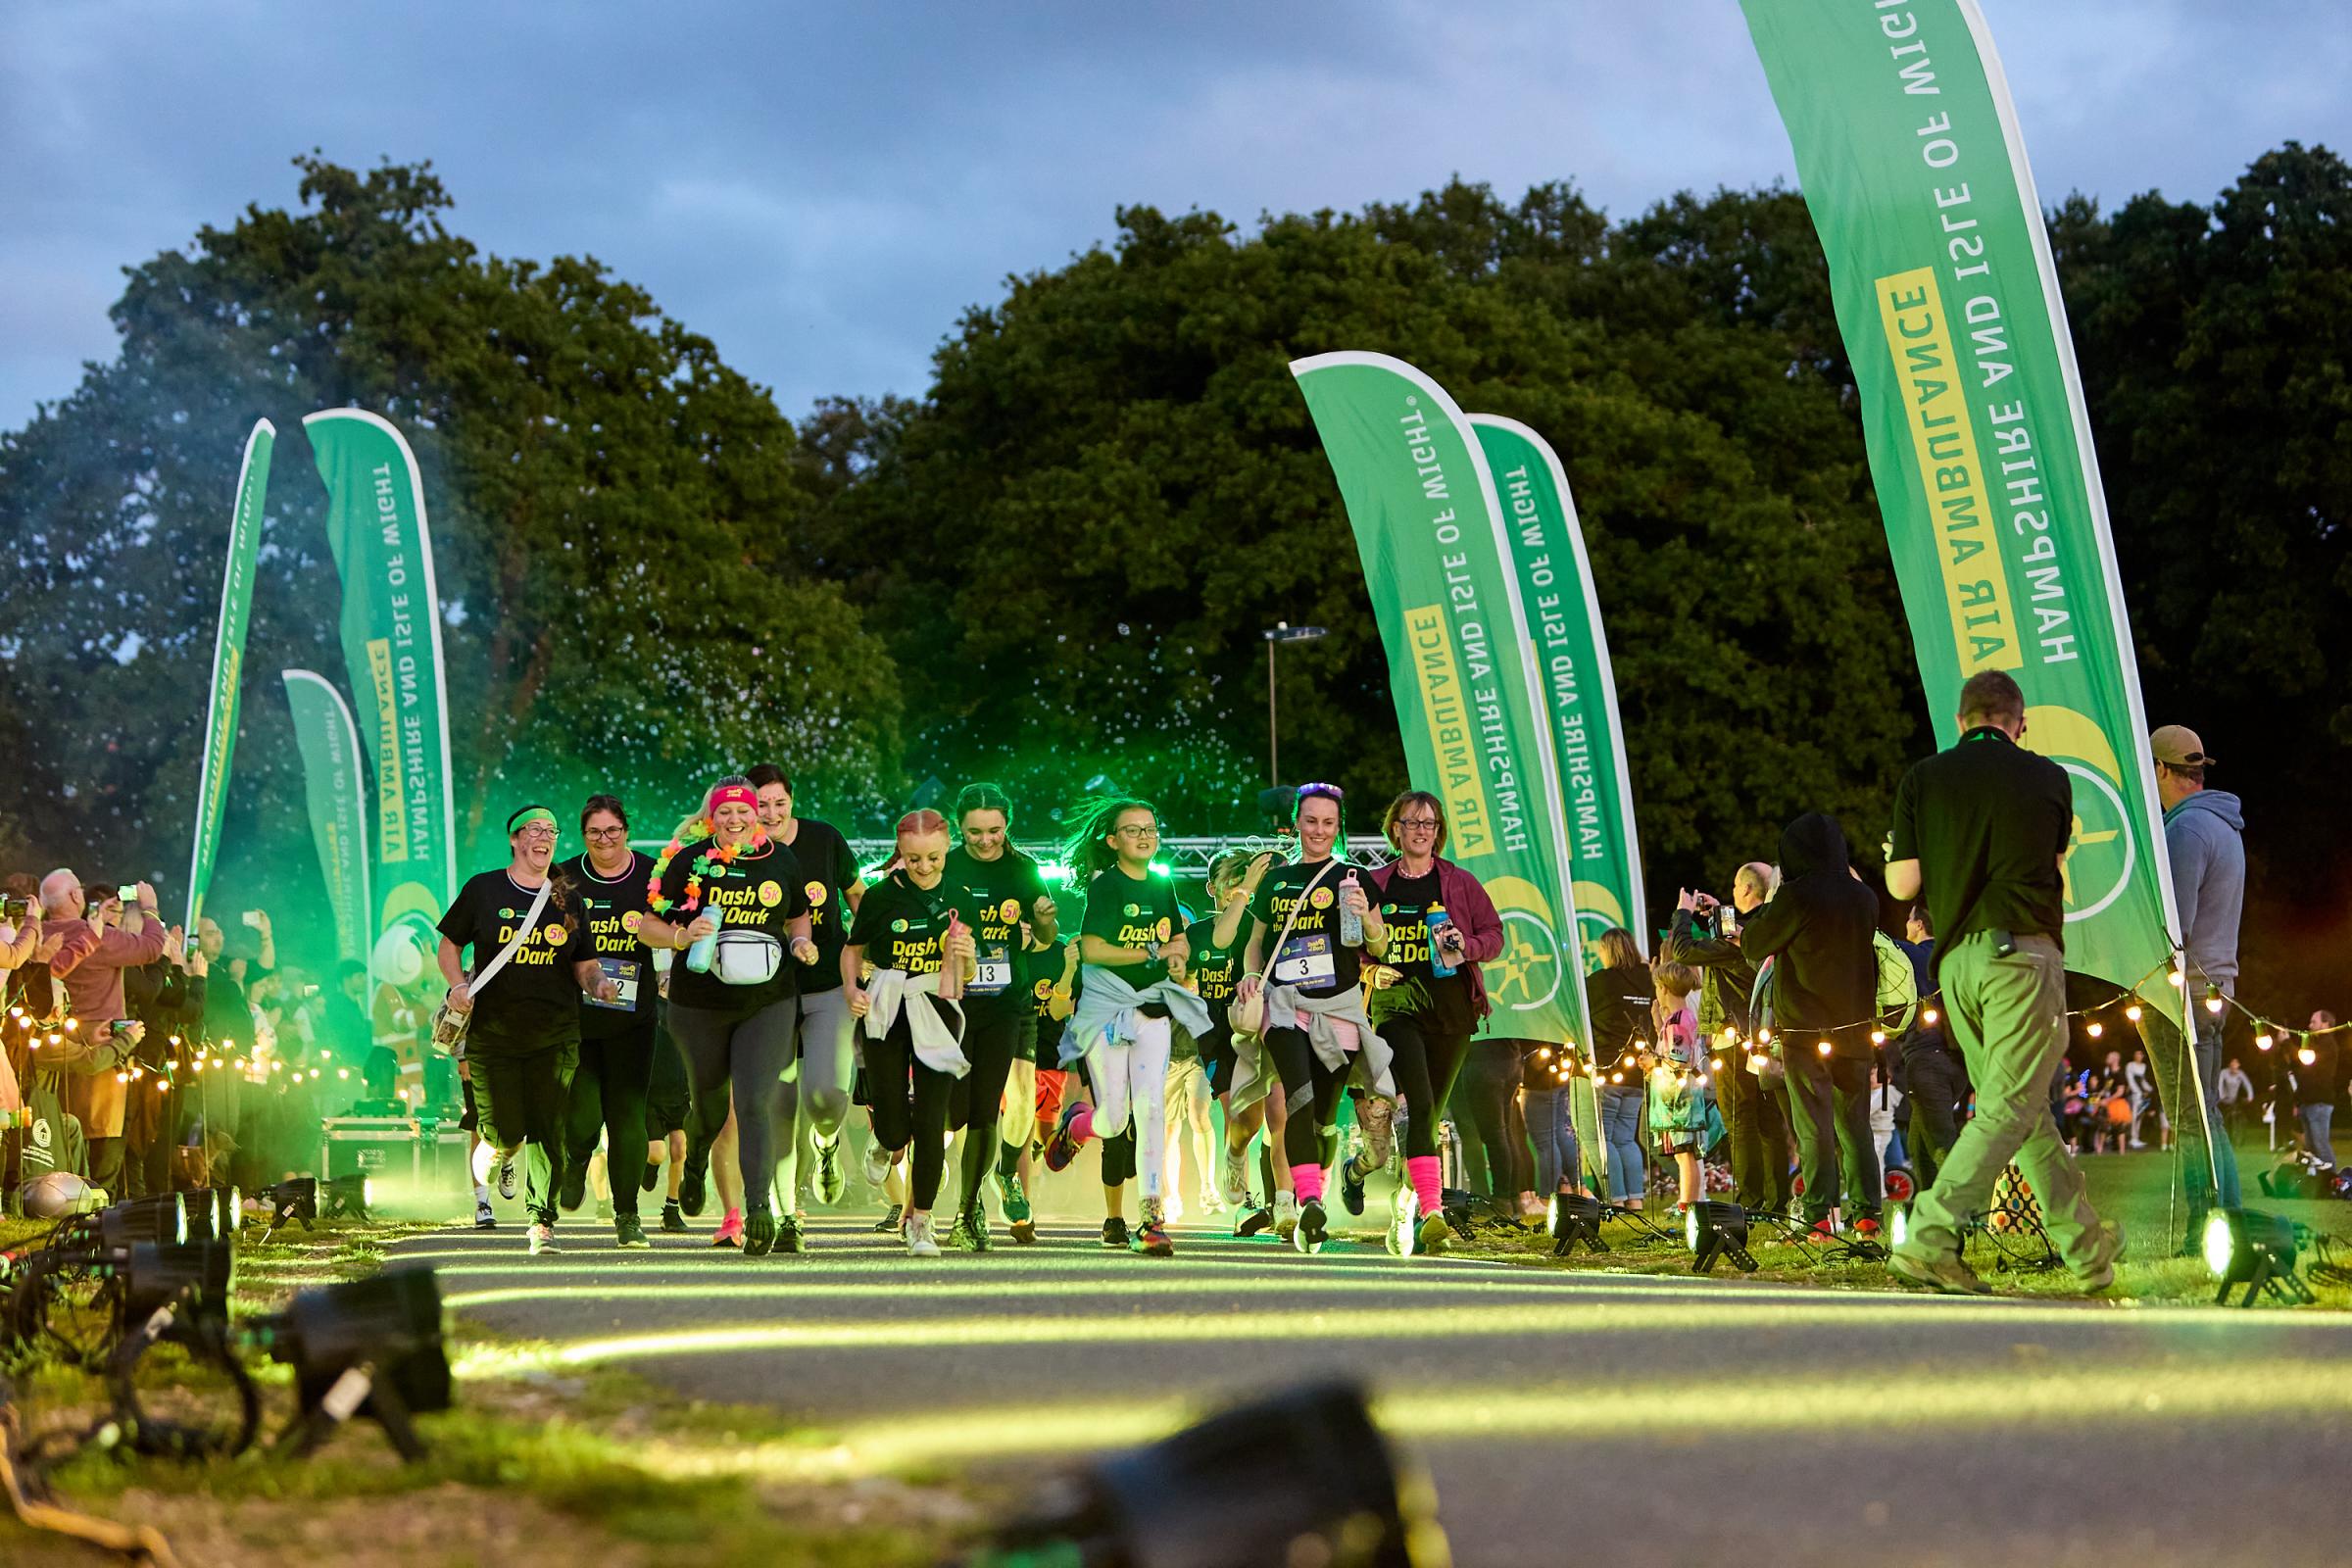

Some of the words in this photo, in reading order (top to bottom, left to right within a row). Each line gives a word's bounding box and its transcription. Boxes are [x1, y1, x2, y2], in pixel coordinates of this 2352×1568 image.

[708, 886, 757, 906] Dash
[724, 906, 769, 924] Dark
[980, 905, 998, 921] sh
[590, 916, 619, 933] ash
[982, 925, 1010, 940] ark
[1118, 922, 1156, 941] Dash
[596, 935, 637, 952] Dark
[892, 937, 937, 956] Dash
[1393, 942, 1401, 954] in
[514, 946, 557, 964] Dark
[1388, 953, 1402, 964] the
[1404, 943, 1429, 963] Da
[909, 956, 942, 973] Dar
[1299, 958, 1309, 975] 3
[979, 966, 995, 982] 13
